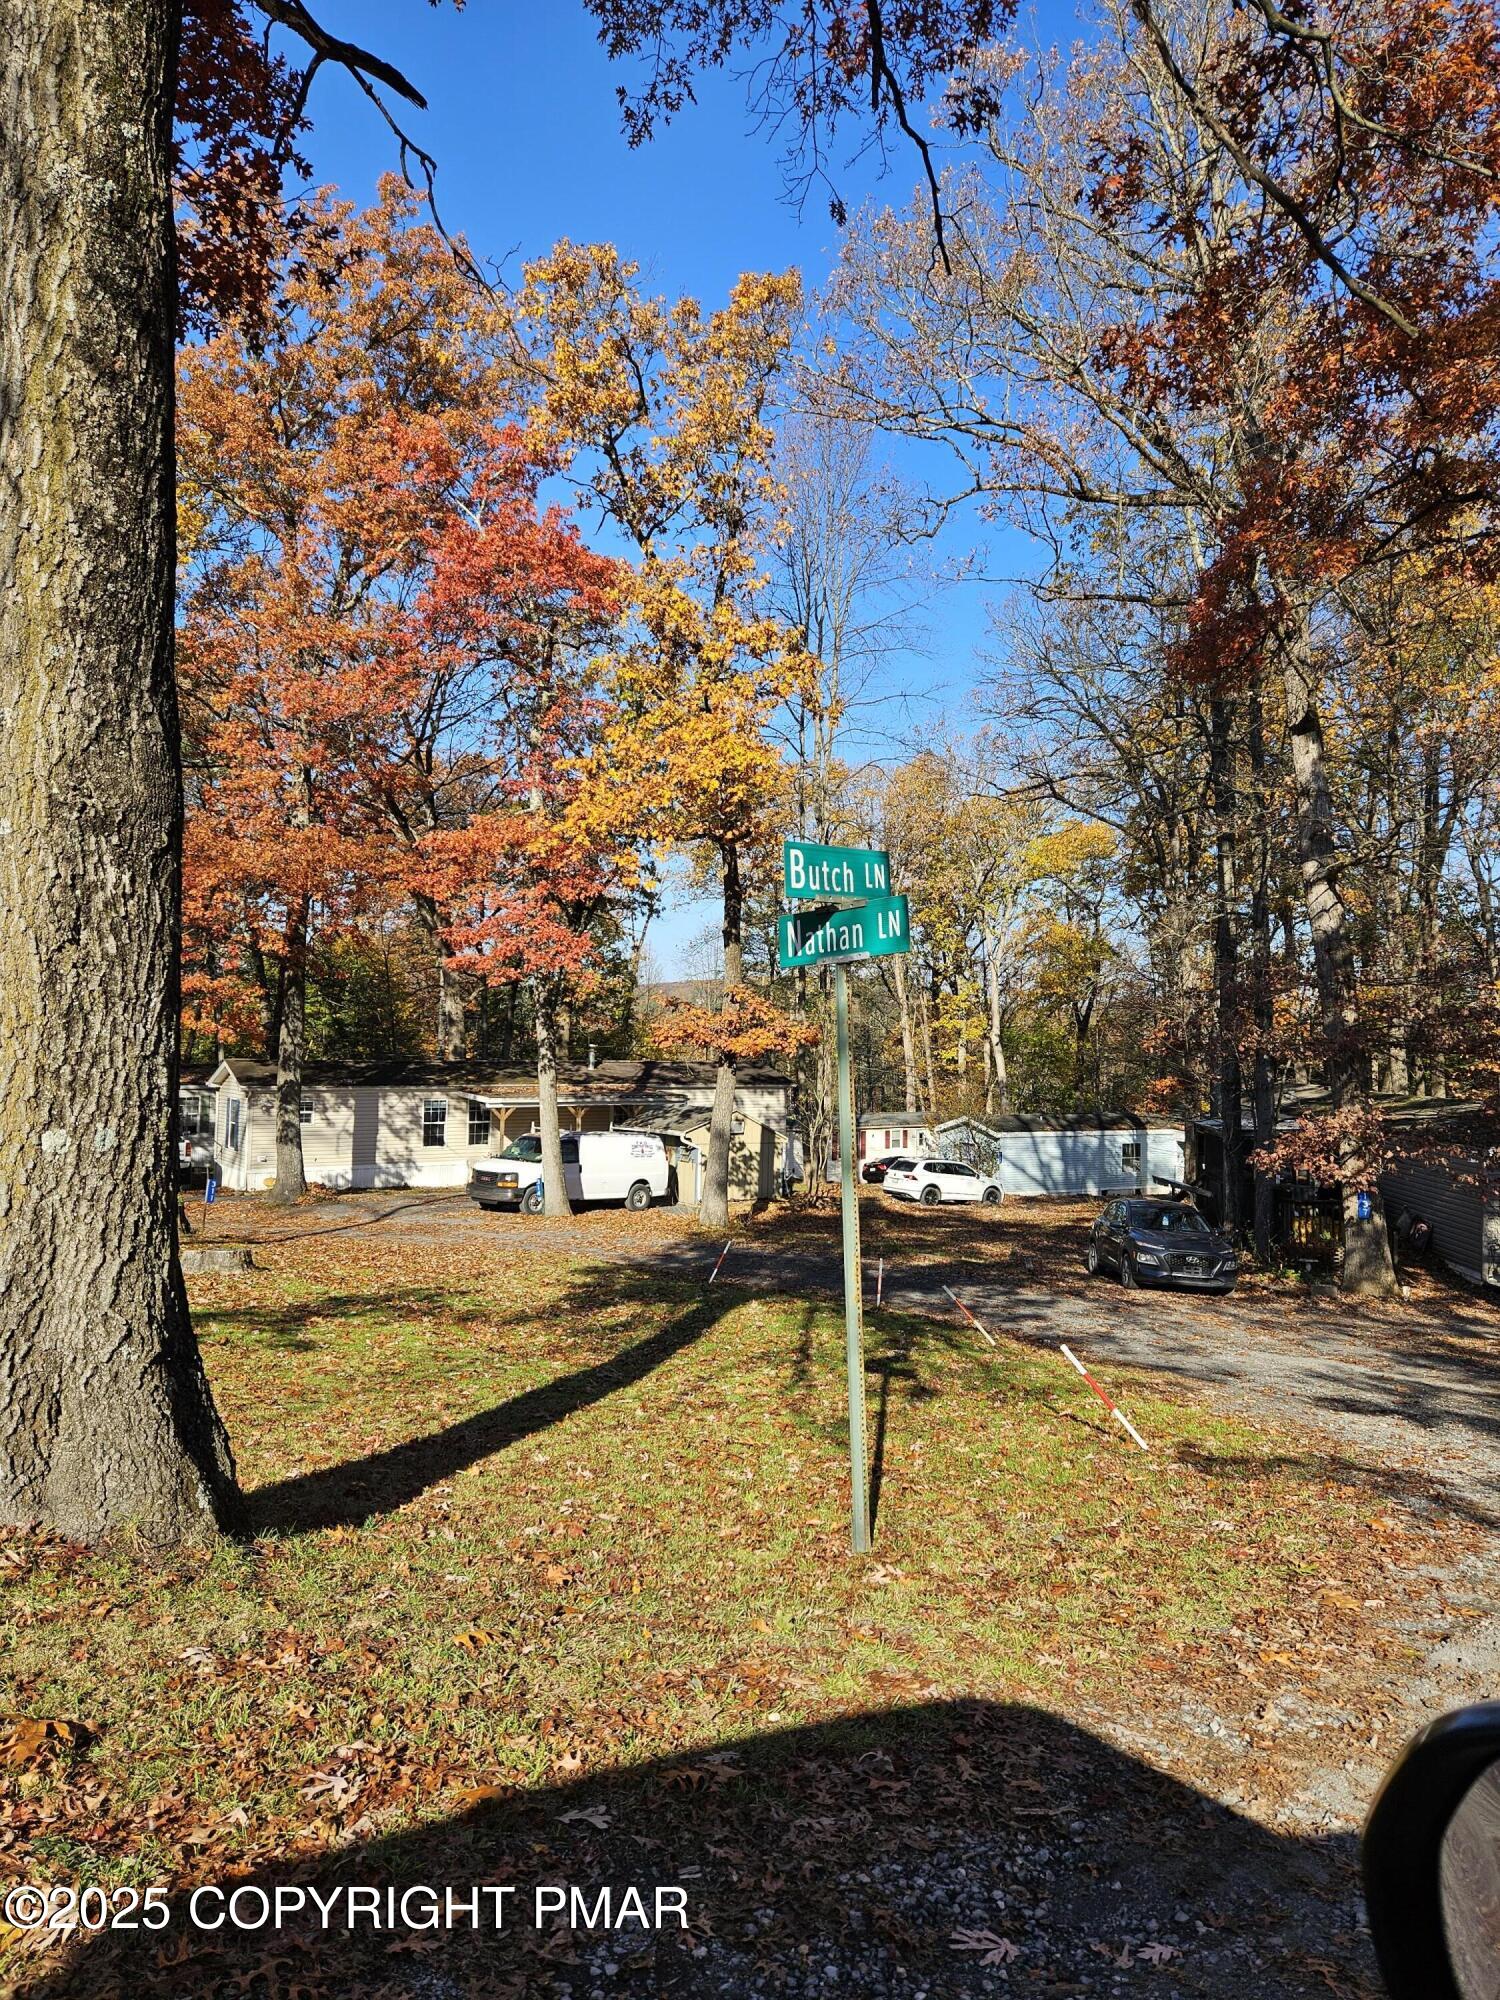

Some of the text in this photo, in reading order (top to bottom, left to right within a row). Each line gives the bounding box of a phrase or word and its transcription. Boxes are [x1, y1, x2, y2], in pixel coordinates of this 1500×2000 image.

[789, 849, 885, 893] Butch LN
[786, 910, 900, 958] Nathan LN
